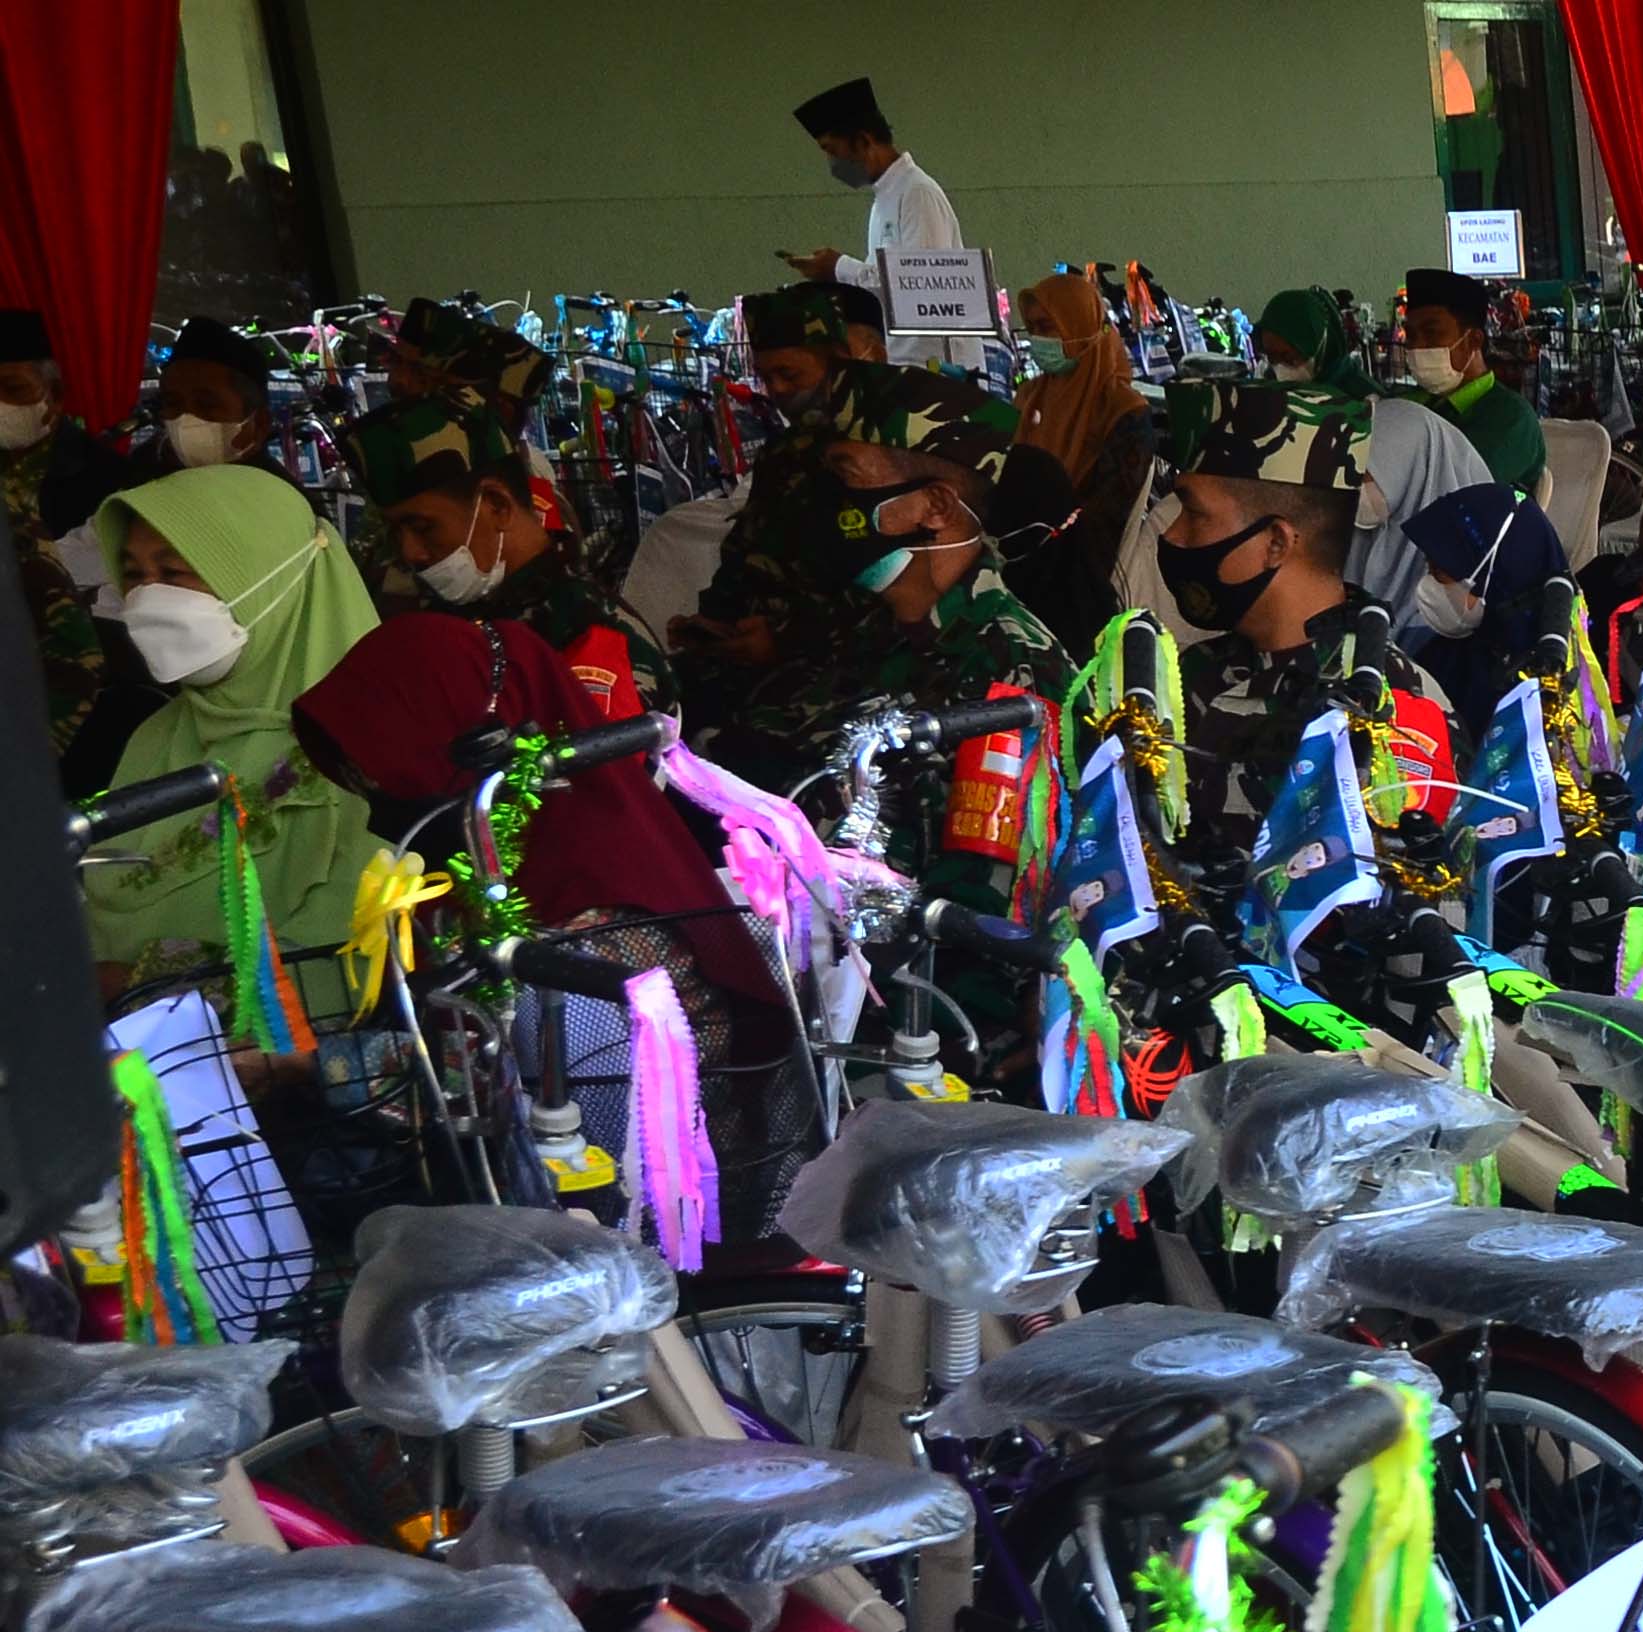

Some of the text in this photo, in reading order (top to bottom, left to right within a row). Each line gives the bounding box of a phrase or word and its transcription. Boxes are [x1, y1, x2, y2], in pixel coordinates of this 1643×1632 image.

[1458, 231, 1508, 245] KECAMATAN
[900, 257, 968, 267] UPZIS LAZISNU
[1472, 252, 1497, 265] BAE
[897, 275, 976, 292] KECAMATAN
[916, 302, 966, 318] DAWE
[1345, 1104, 1417, 1131] PHOENIX
[979, 1157, 1062, 1186] PHOENIX
[516, 1270, 607, 1307] PHOENIX
